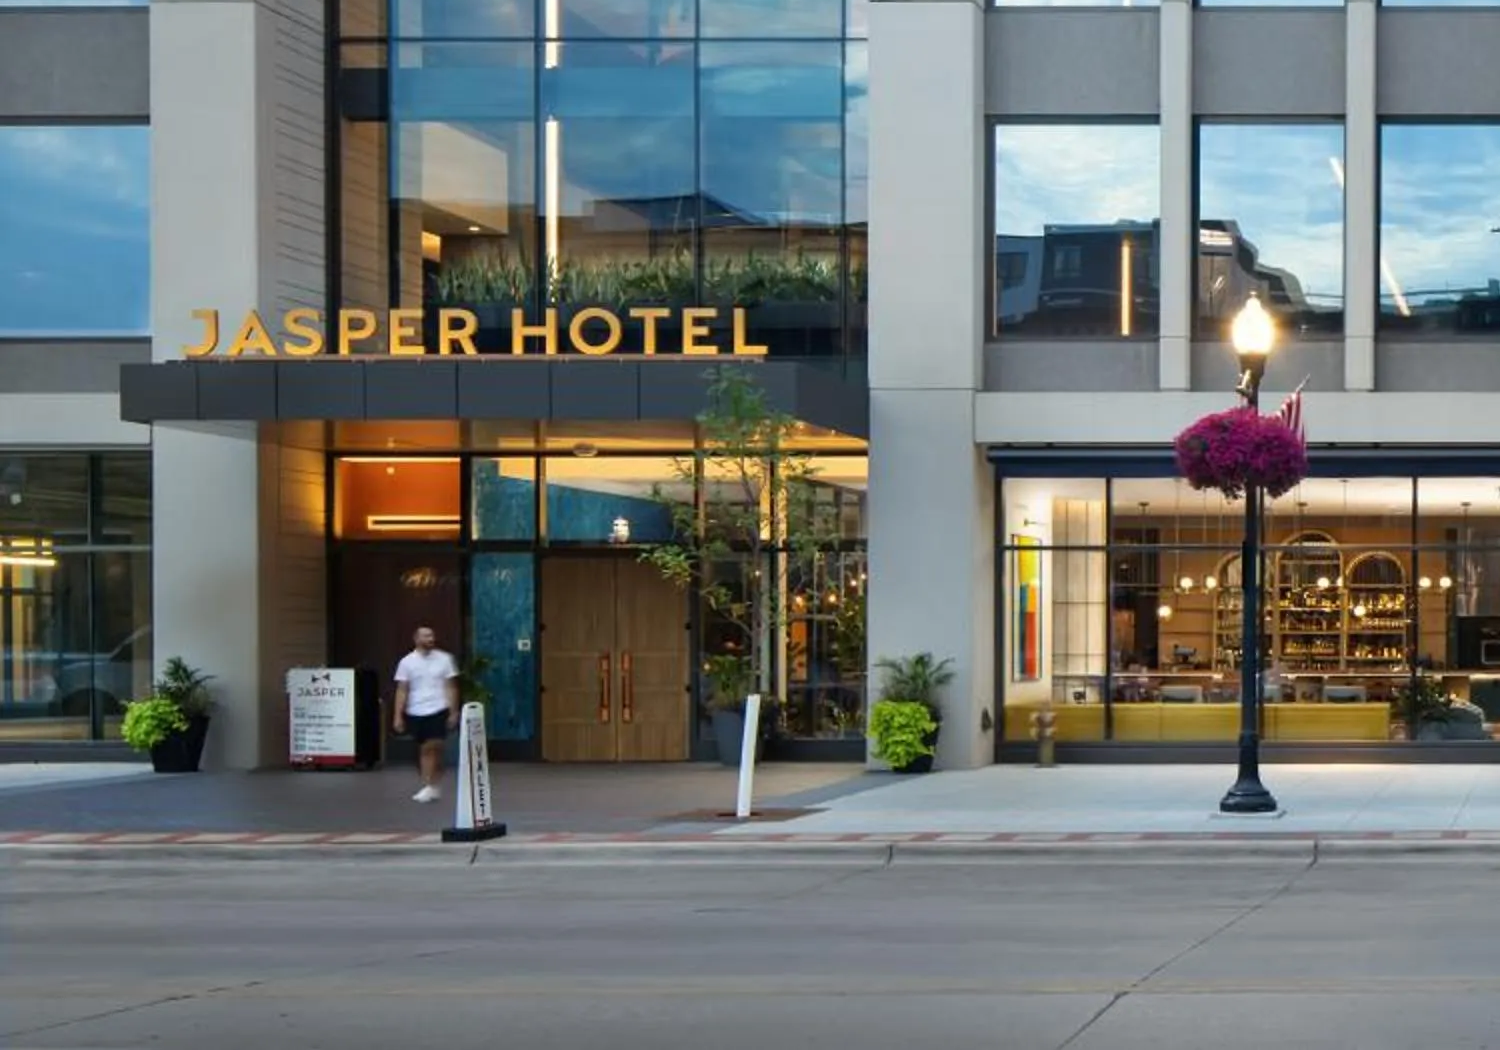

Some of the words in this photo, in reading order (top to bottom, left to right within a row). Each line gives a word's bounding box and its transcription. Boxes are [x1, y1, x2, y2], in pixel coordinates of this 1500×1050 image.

[183, 308, 480, 357] JASPER
[511, 307, 769, 356] HOTEL
[297, 687, 345, 698] JASPER
[475, 744, 486, 816] VALET
